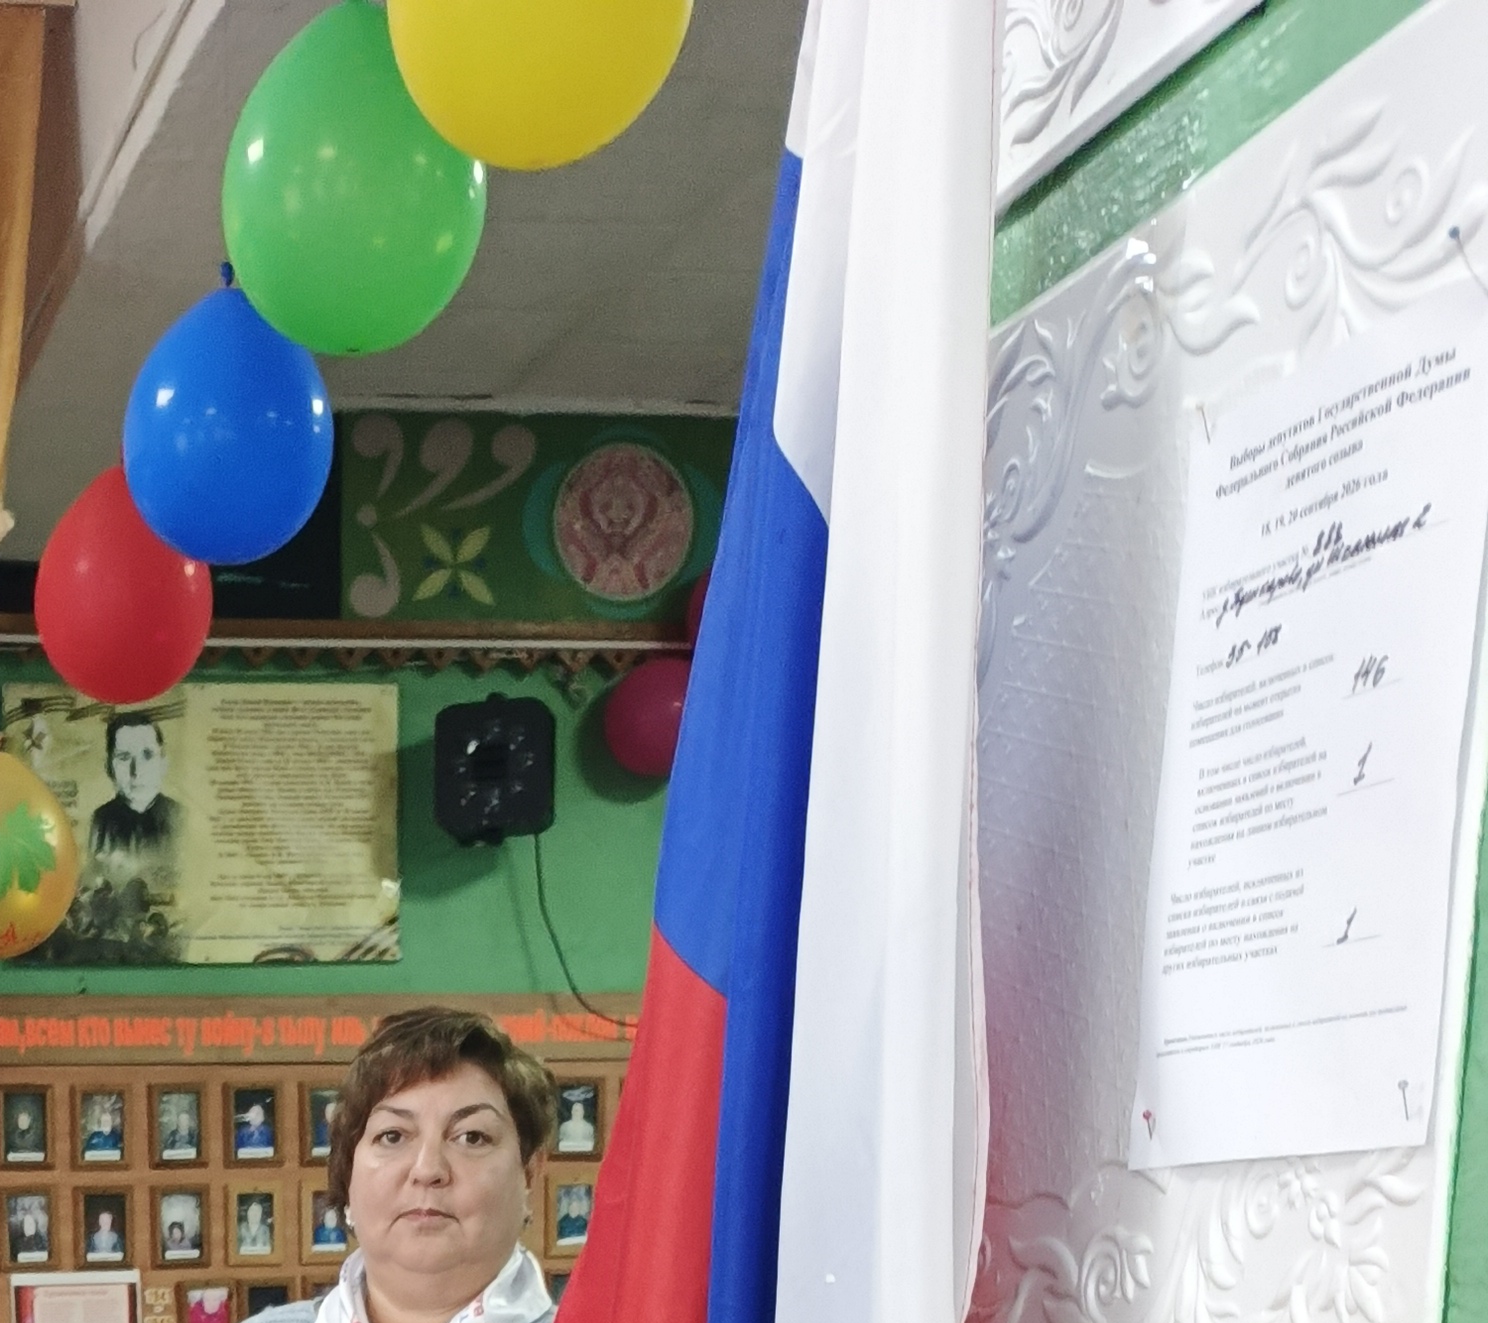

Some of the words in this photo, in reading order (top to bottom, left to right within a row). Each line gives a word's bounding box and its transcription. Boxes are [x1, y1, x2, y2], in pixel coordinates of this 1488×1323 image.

[1414, 347, 1457, 378] Думы
[1330, 398, 1392, 441] Российской
[1396, 368, 1470, 407] Федерации
